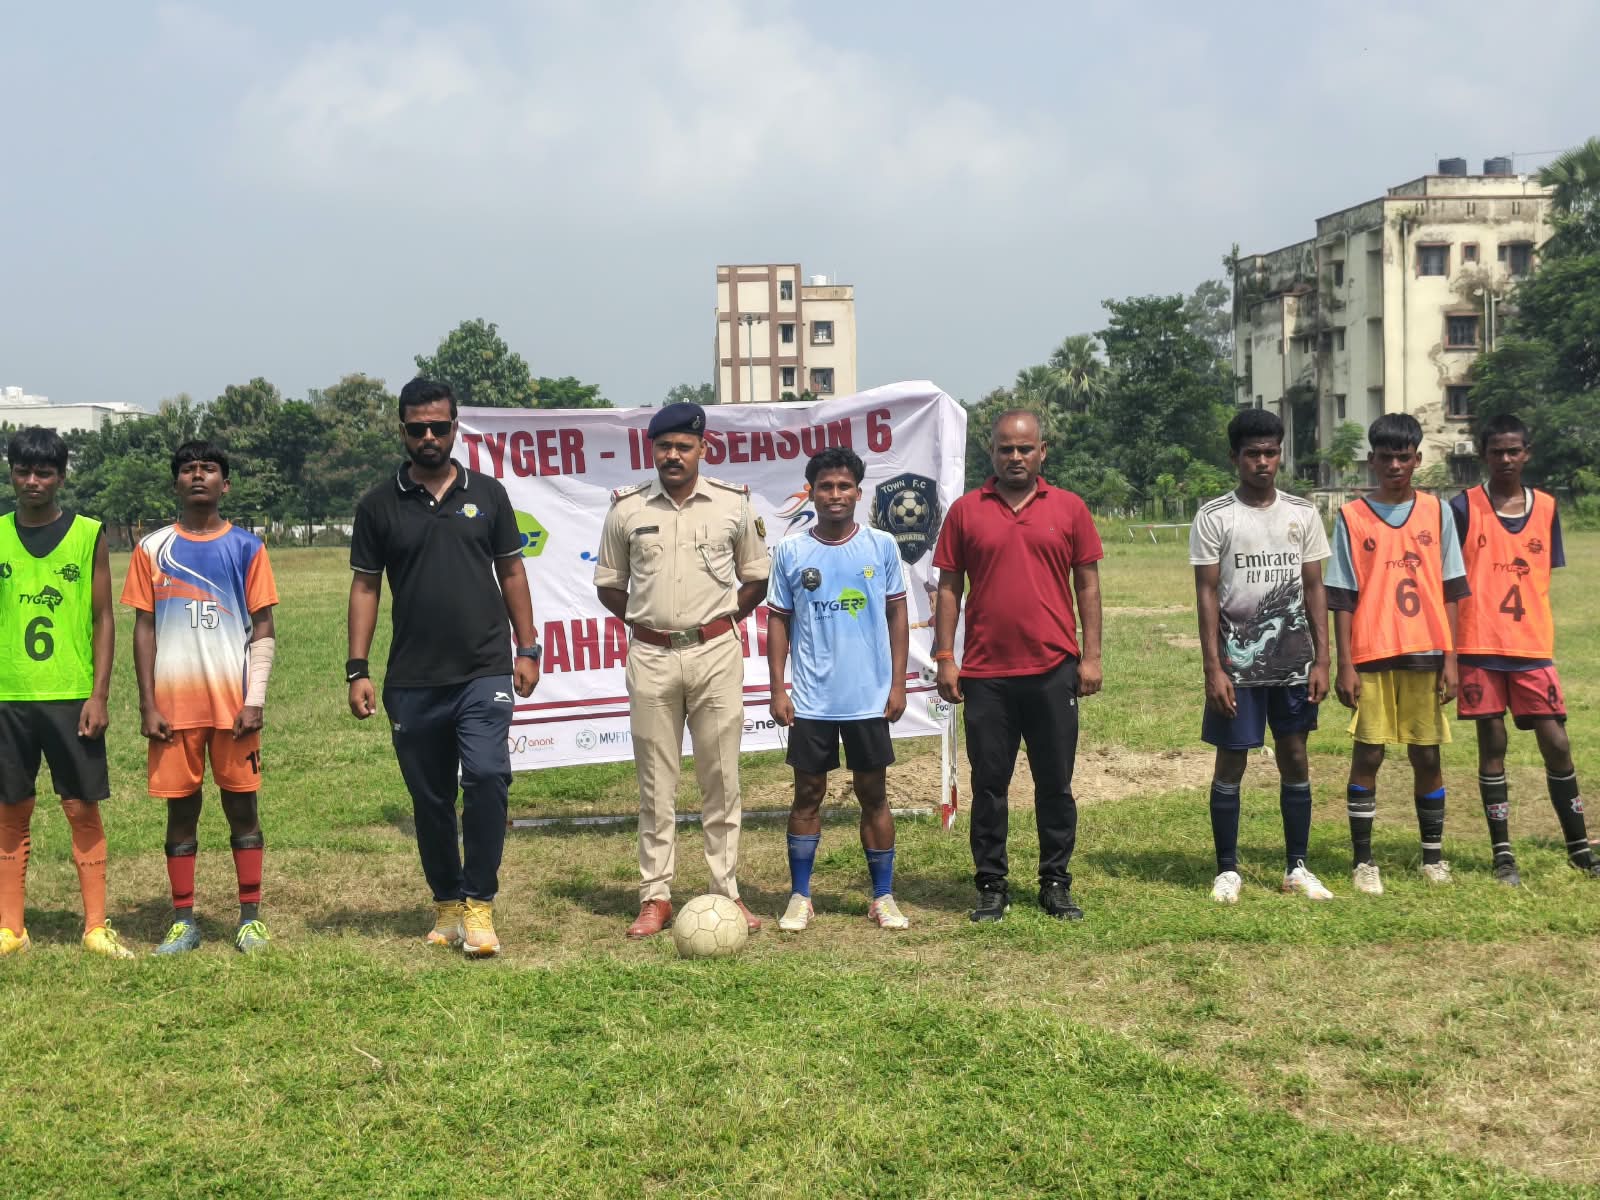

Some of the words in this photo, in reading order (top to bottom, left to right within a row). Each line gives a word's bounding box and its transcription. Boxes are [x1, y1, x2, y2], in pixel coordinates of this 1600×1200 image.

[462, 428, 586, 479] TYGER
[703, 418, 853, 465] SEASON
[867, 408, 892, 453] 6
[881, 480, 906, 494] TOWN
[1234, 550, 1299, 569] Emirates
[1247, 571, 1261, 584] FLY
[1265, 569, 1294, 583] BETTER
[813, 598, 864, 612] TYGER
[1396, 578, 1421, 618] 6
[1499, 583, 1526, 622] 4
[185, 599, 220, 630] 15
[24, 616, 55, 661] 6
